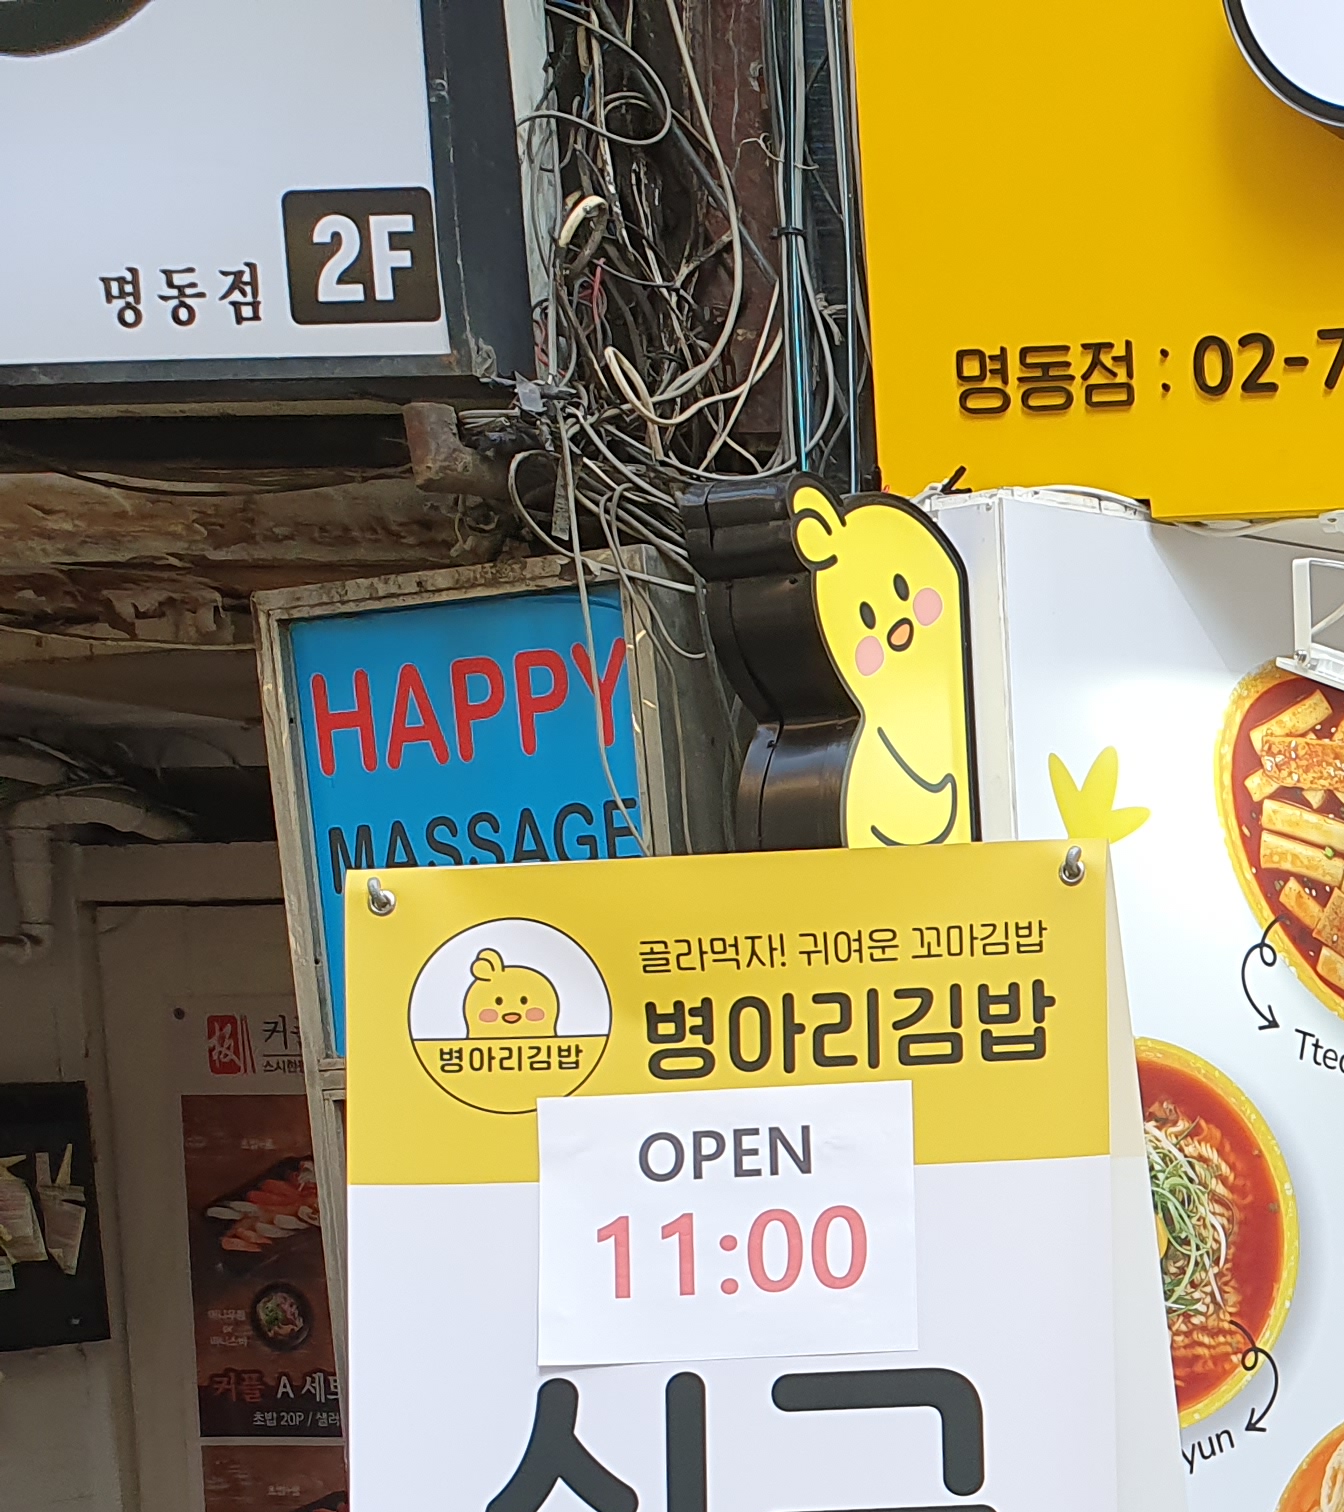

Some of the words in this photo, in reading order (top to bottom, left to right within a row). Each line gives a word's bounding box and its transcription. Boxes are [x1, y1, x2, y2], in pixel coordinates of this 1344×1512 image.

[309, 213, 414, 304] 2F
[98, 262, 264, 329] 명동점
[954, 338, 1135, 415] 명동점
[310, 635, 631, 777] HAPPY
[328, 797, 639, 895] MASSAGE
[637, 933, 787, 975] 골라먹자!
[799, 927, 900, 968] 귀여운
[911, 919, 1048, 960] 꼬마김밥
[438, 1043, 584, 1074] 병아리김밥
[644, 978, 1057, 1081] 병아리김밥
[637, 1123, 814, 1182] OPEN
[595, 1204, 869, 1301] 11:00
[252, 1411, 277, 1427] 초밥
[279, 1412, 305, 1426] 20P
[276, 1375, 295, 1399] A
